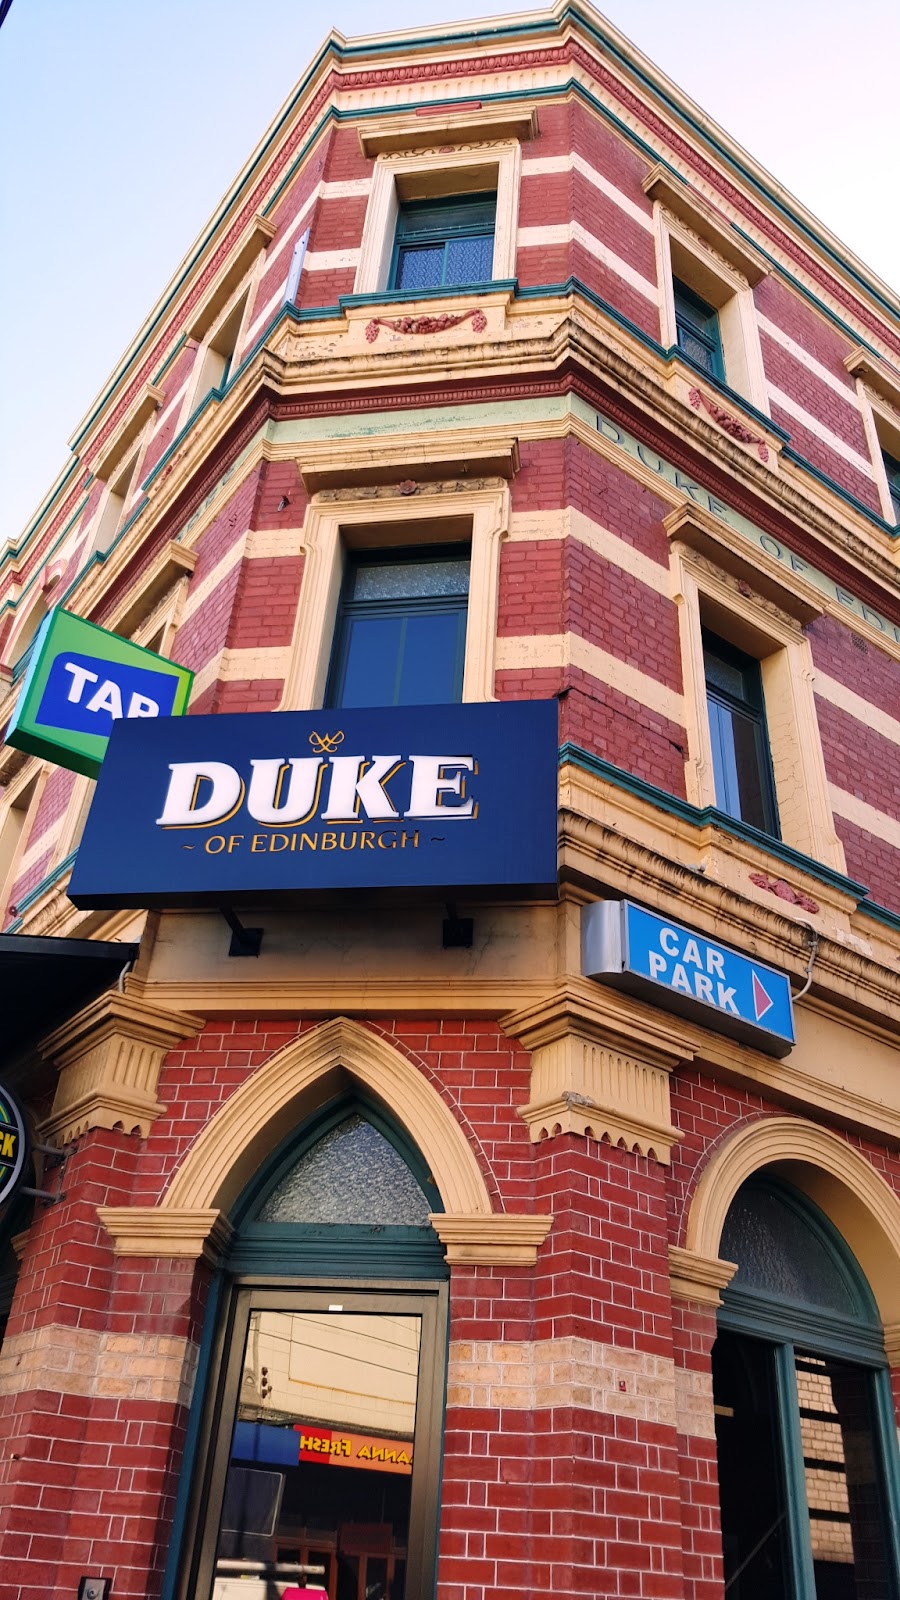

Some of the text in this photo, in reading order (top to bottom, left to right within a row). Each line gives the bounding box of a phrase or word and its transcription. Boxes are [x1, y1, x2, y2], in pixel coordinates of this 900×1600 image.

[596, 414, 728, 521] DUKE
[760, 535, 809, 572] OF
[155, 754, 478, 829] DUKE
[205, 830, 419, 854] OF EDINBURGH
[649, 950, 741, 1016] PARK
[659, 927, 727, 981] CAR
